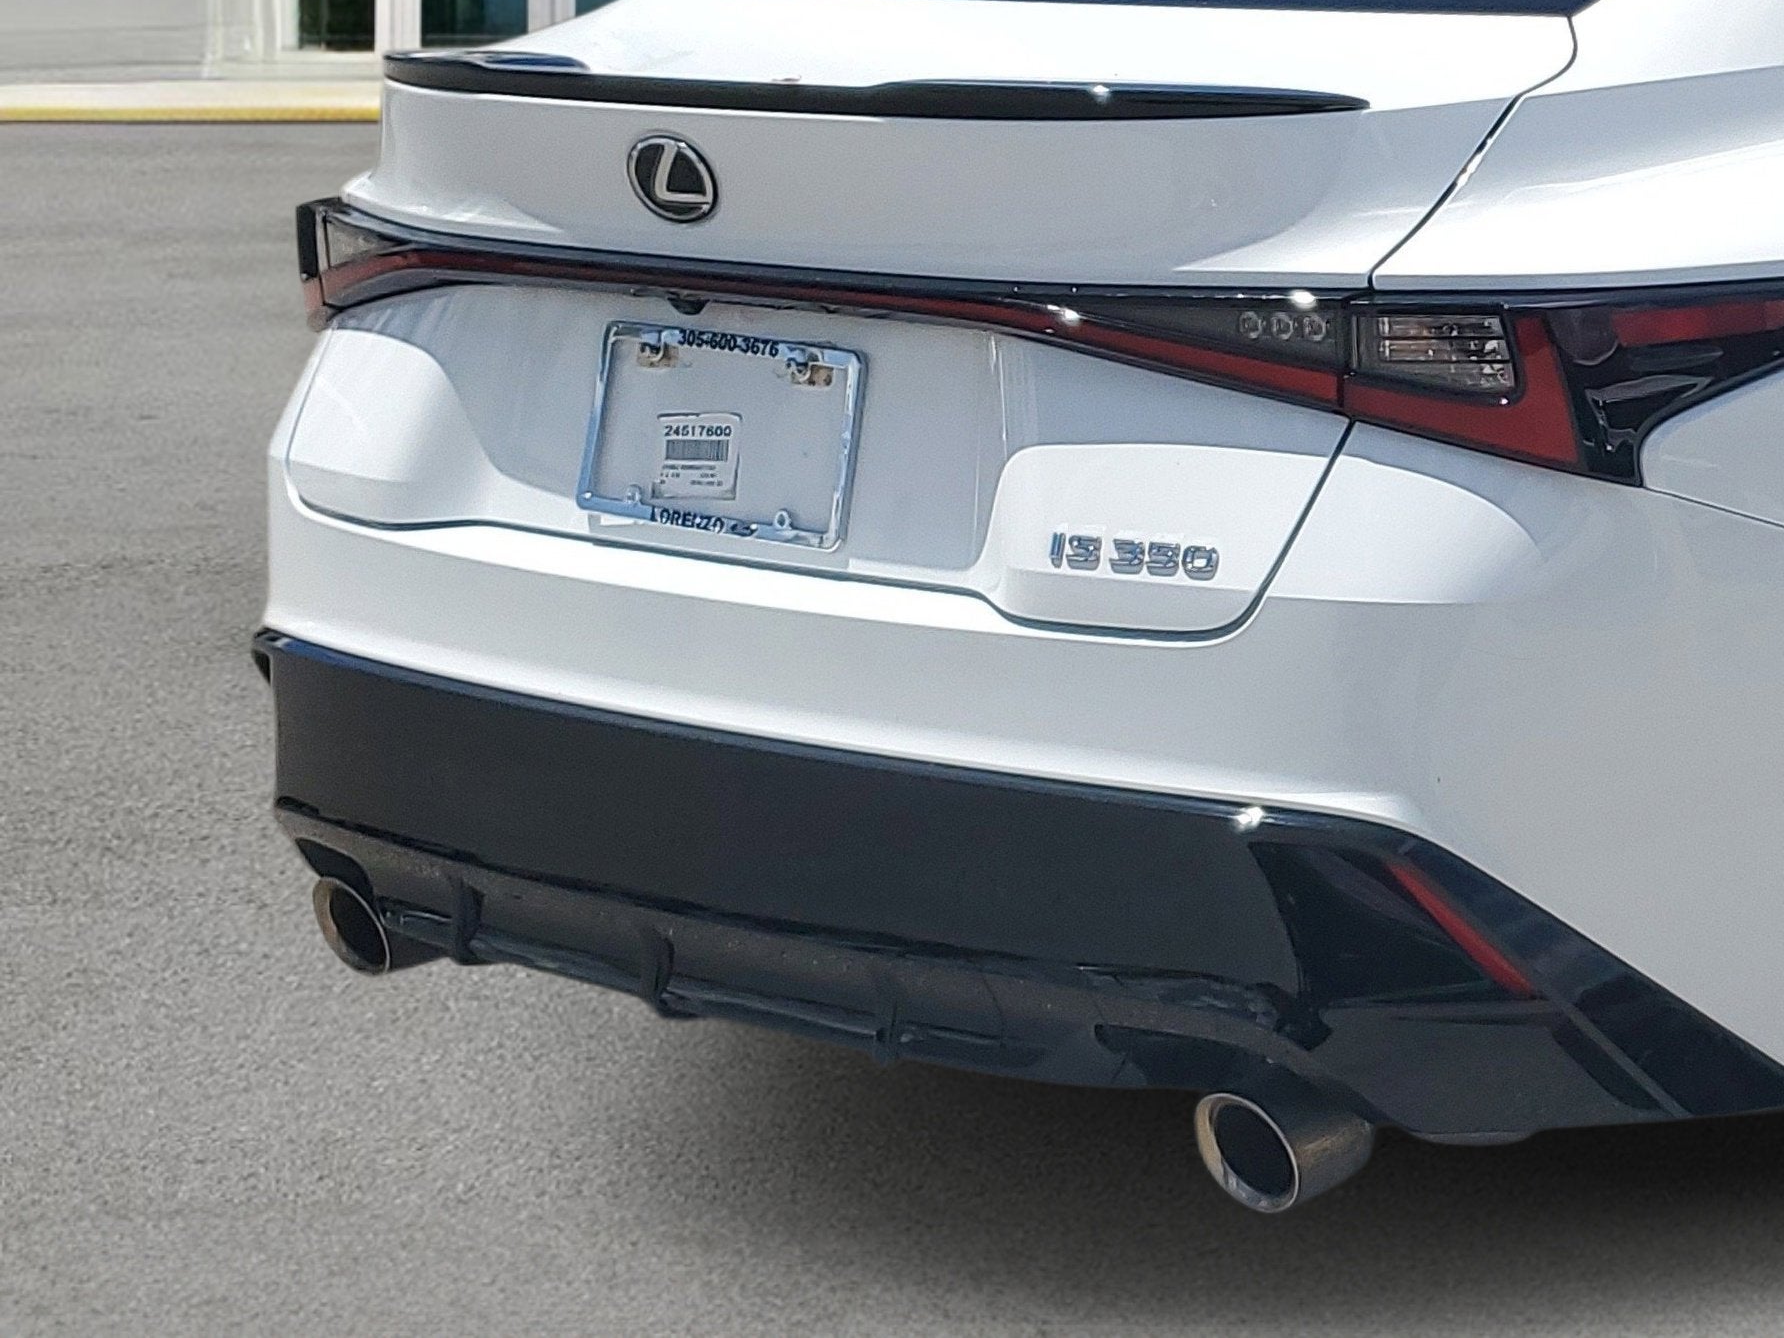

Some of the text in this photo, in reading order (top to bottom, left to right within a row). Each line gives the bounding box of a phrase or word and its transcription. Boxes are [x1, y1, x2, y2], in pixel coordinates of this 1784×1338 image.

[678, 327, 780, 358] 305-600-3676
[649, 505, 726, 534] LORENZO
[1050, 531, 1220, 581] IS 350
